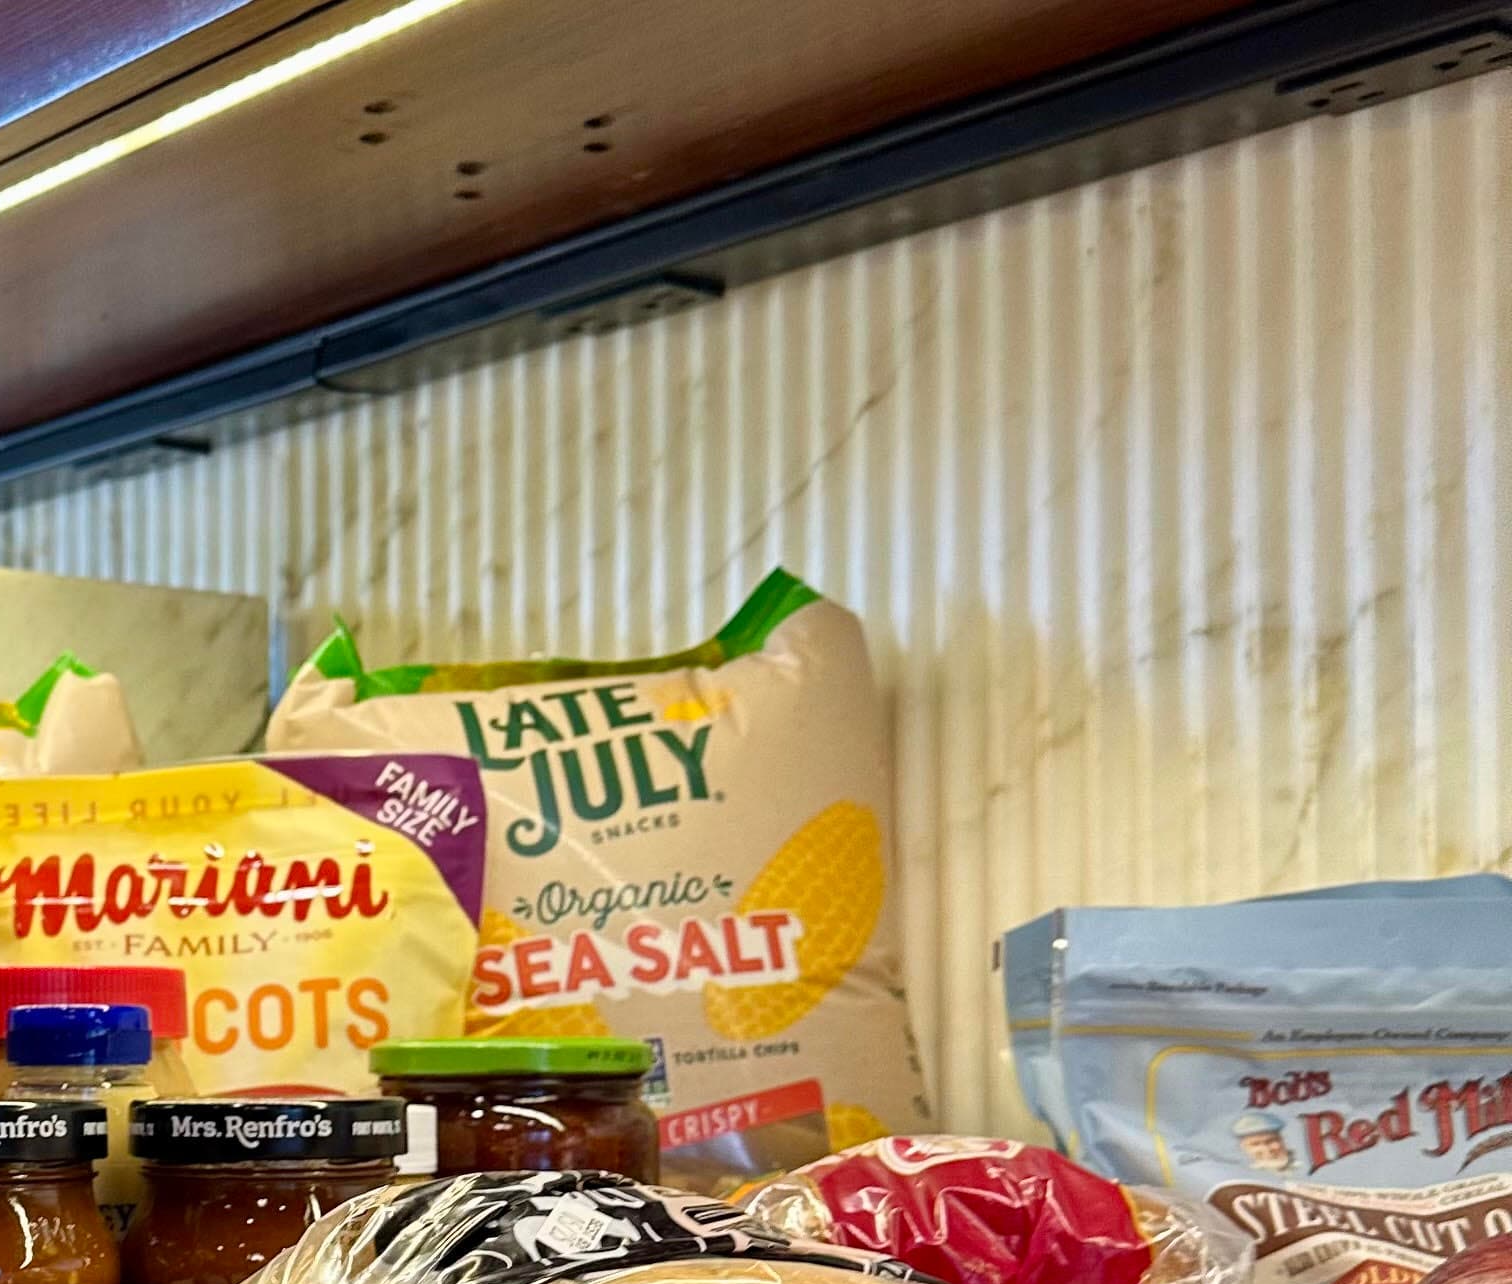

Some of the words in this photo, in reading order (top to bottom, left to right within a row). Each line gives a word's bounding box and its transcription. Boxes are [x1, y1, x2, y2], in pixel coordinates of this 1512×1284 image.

[452, 682, 654, 770] LATE
[375, 761, 479, 836] FAMILY
[506, 724, 713, 857] JULY
[376, 798, 443, 848] SIZE
[591, 813, 681, 846] SNACKS
[536, 873, 712, 929] Organic
[123, 930, 277, 957] FAMILY
[475, 930, 616, 1008] SEA
[631, 913, 794, 985] SALT
[194, 976, 389, 1055] COTS
[674, 1046, 748, 1065] TORTILLA
[752, 1041, 800, 1057] CHIPS
[170, 1115, 223, 1139] Mrs.
[224, 1113, 333, 1149] Renfro's
[667, 1099, 759, 1146] CRISPY
[1299, 1087, 1417, 1175] Red
[1417, 1071, 1512, 1158] Mil
[1232, 1191, 1379, 1245] STEEL
[1384, 1214, 1472, 1254] CUT
